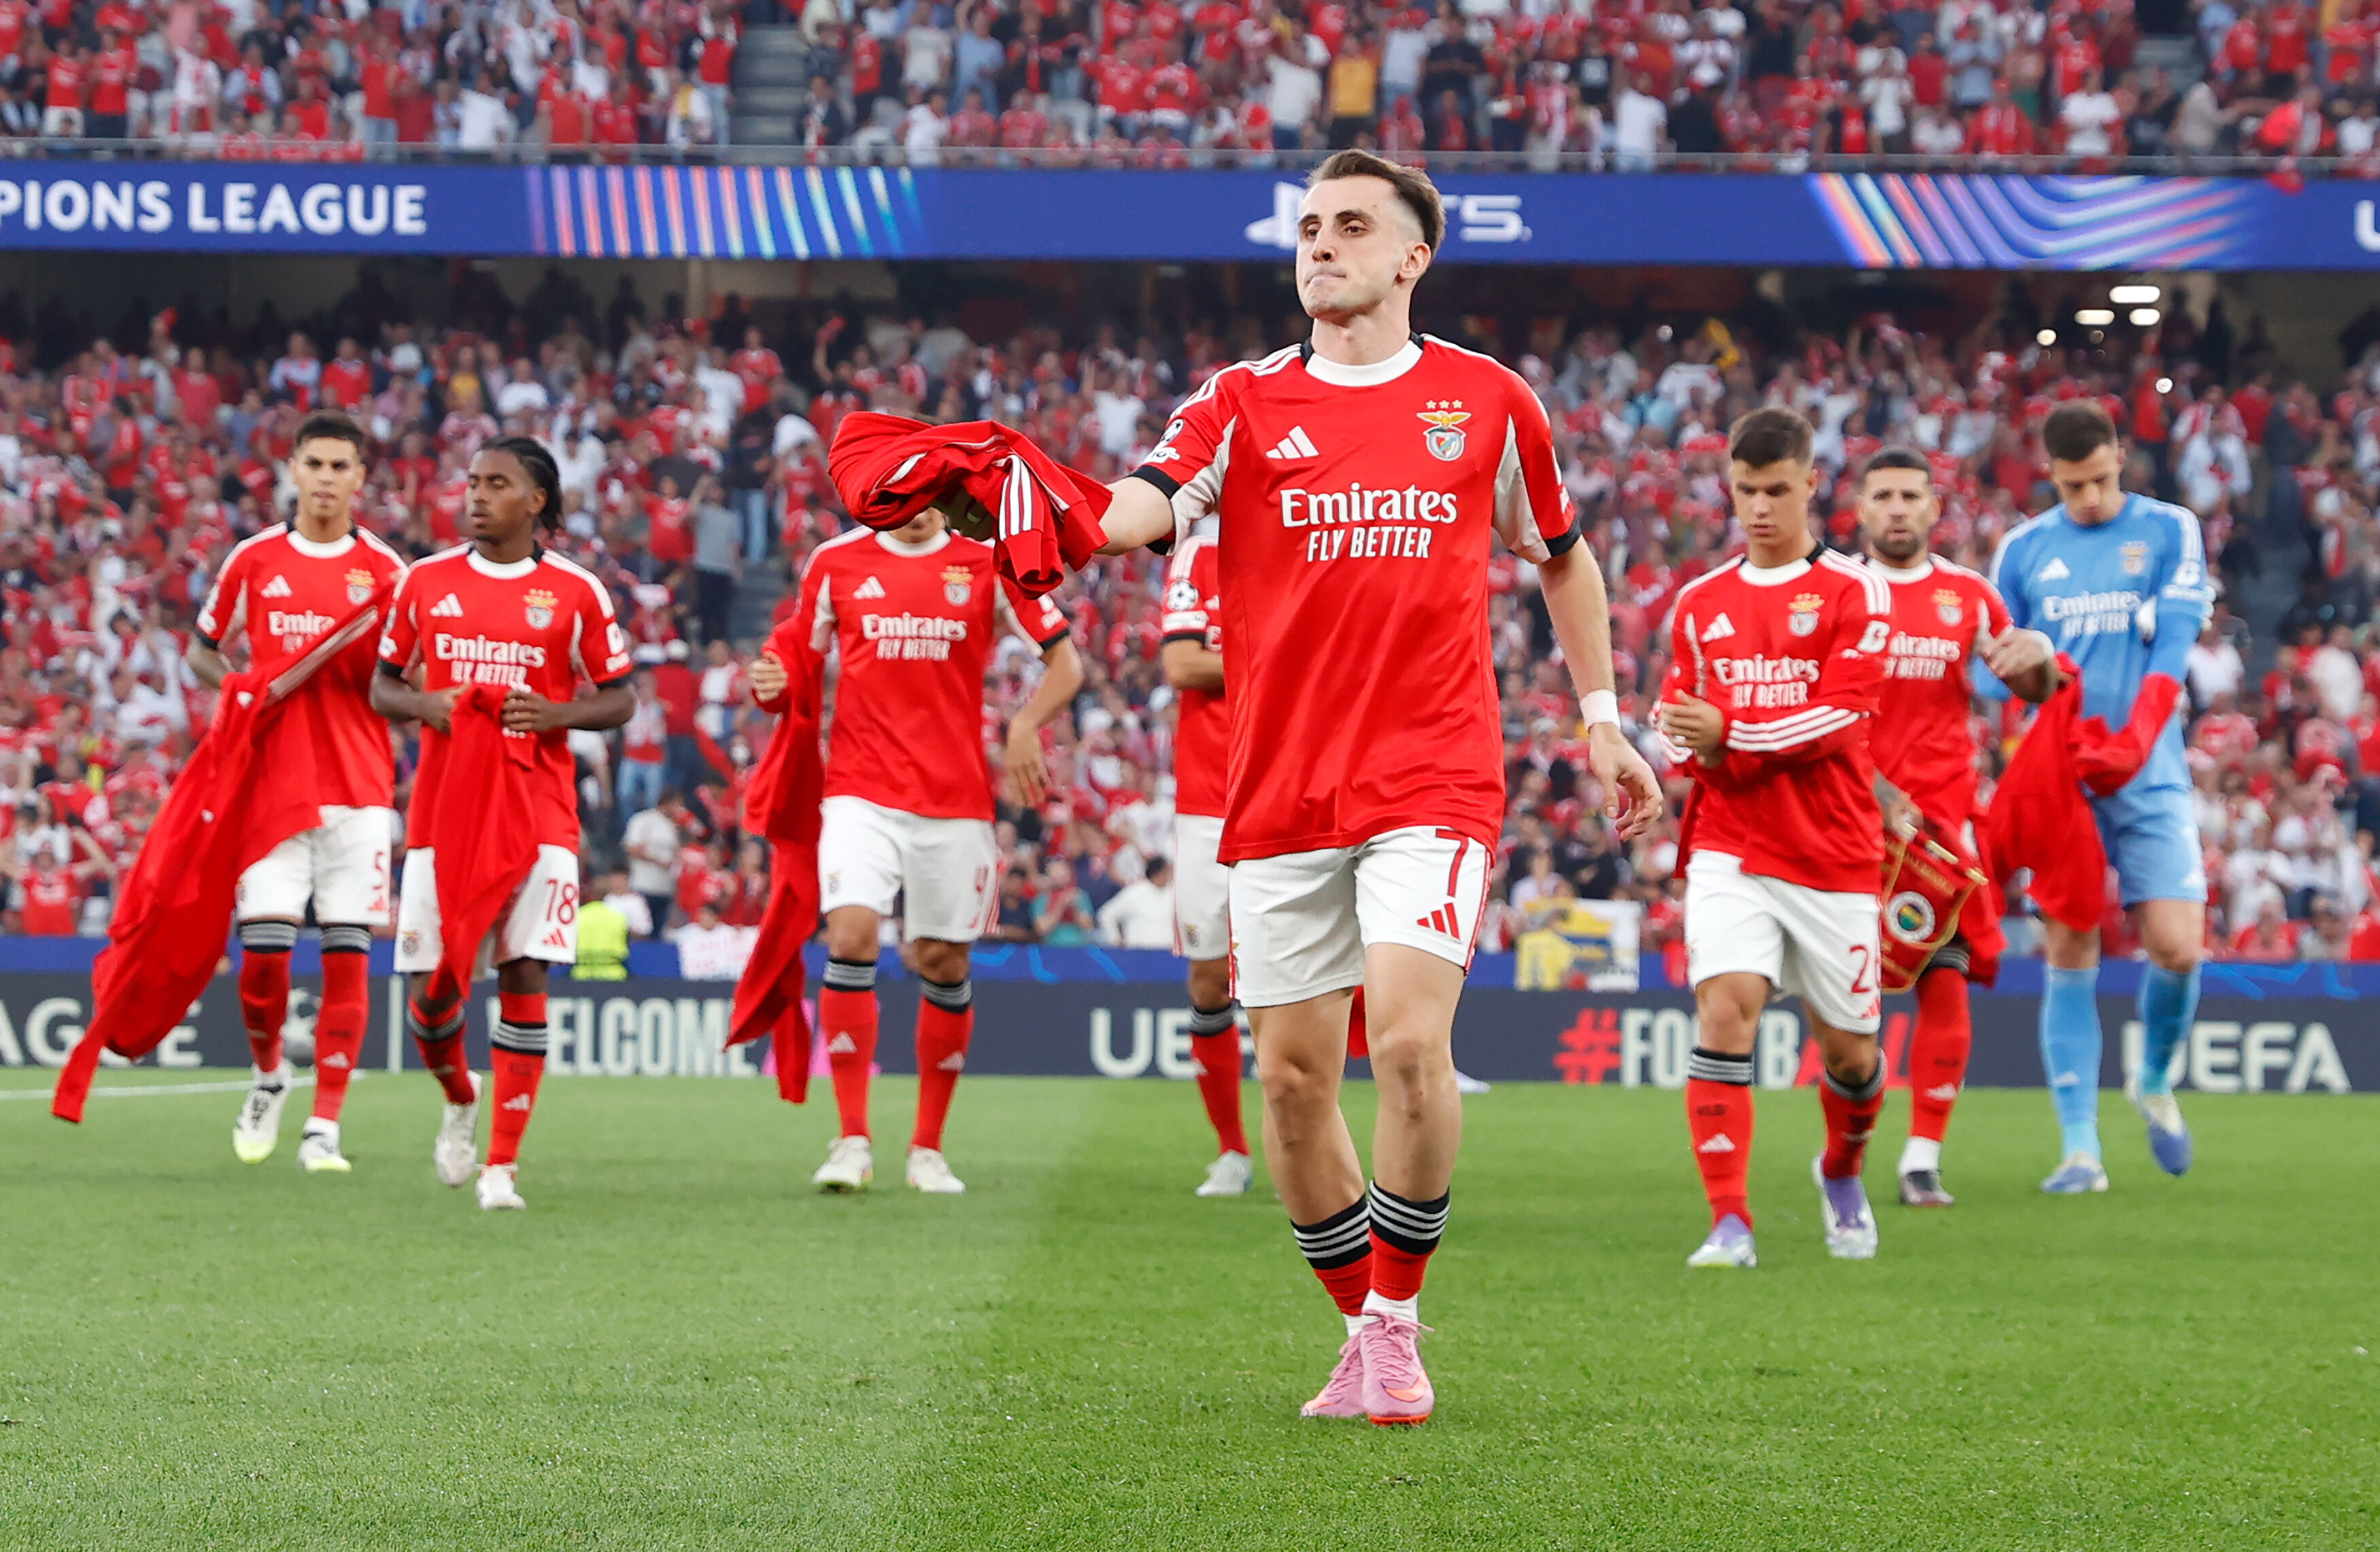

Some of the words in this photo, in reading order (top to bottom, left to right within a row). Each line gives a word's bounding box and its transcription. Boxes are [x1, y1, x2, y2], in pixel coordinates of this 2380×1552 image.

[0, 180, 173, 233] PIONS
[187, 181, 426, 236] LEAGUE
[1280, 482, 1458, 528] Emirates
[1307, 529, 1346, 562] FLY
[1349, 526, 1432, 558] BETTER
[268, 609, 336, 636] Emira
[861, 611, 968, 641] Emirates
[435, 632, 546, 669] Emirates
[1712, 653, 1820, 686] Emirates
[1435, 828, 1469, 898] 7
[1849, 944, 1881, 994] 2
